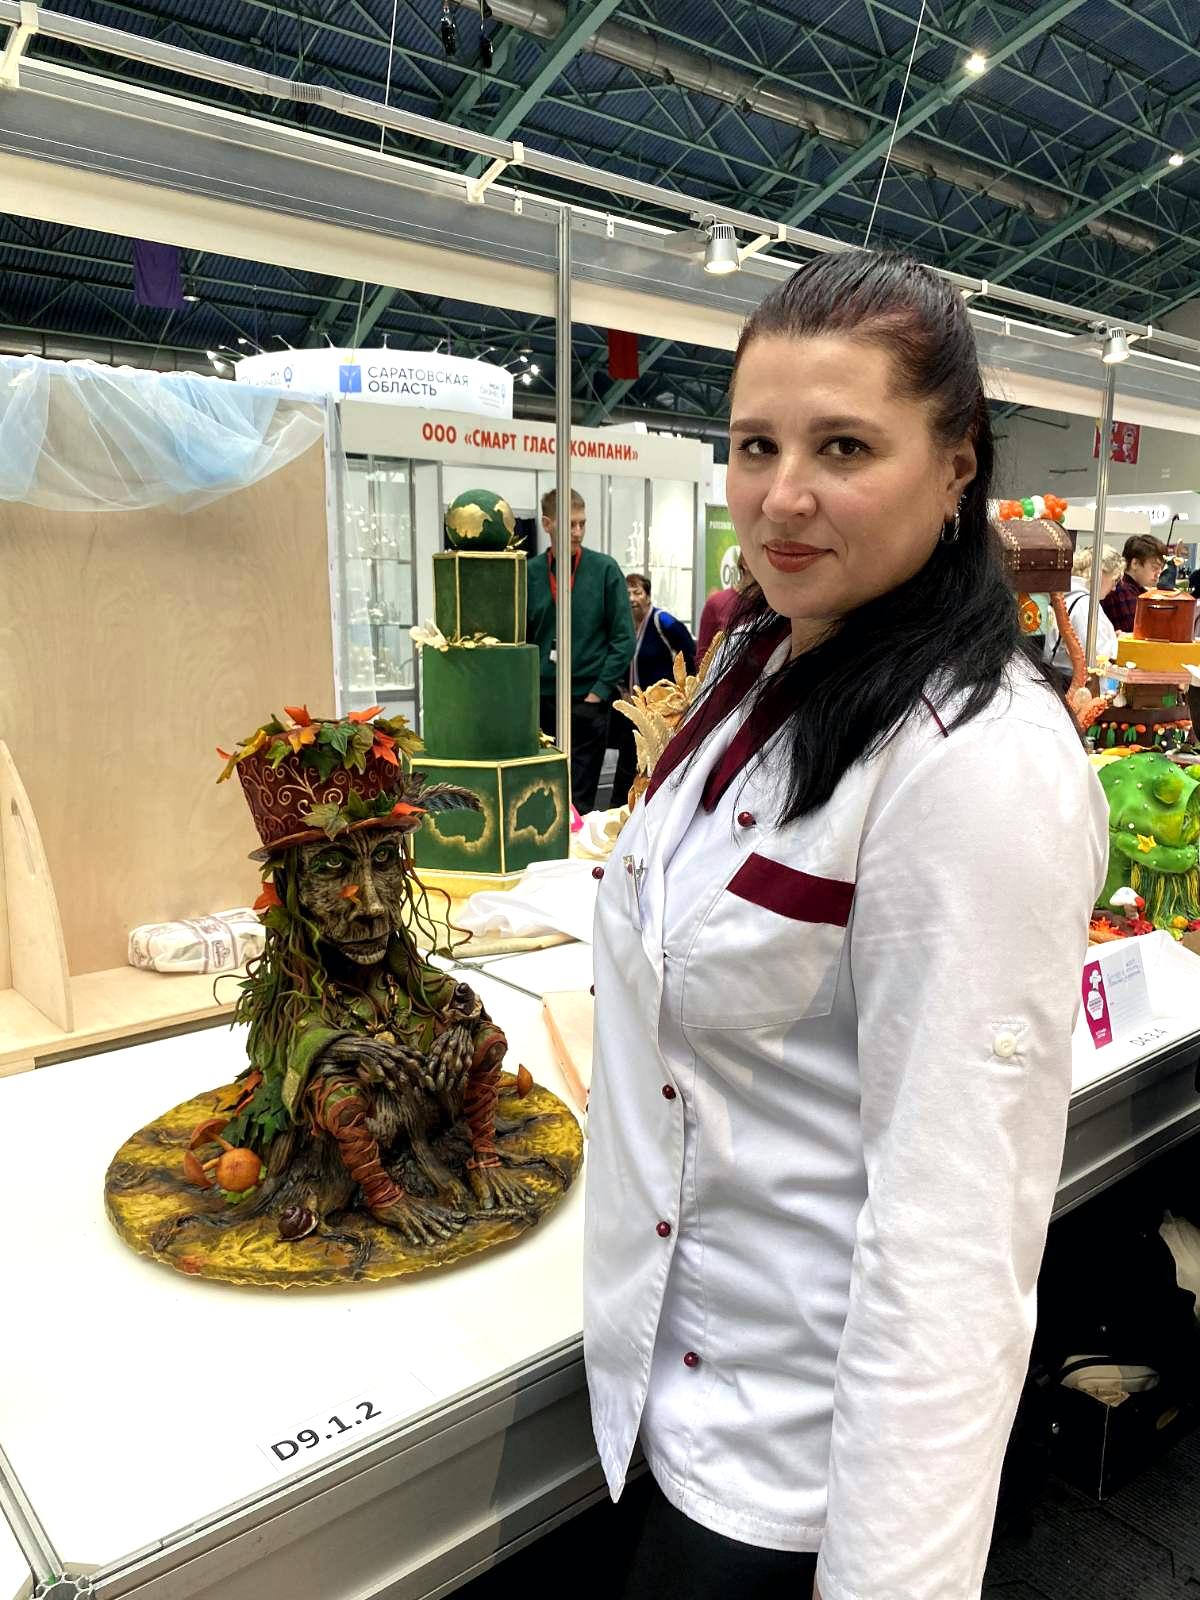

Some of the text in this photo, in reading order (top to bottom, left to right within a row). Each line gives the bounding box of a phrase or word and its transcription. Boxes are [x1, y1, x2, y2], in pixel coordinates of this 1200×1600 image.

[368, 366, 469, 387] САРАТОВСКАЯ
[368, 380, 437, 396] ОБЛАСТЬ
[422, 422, 639, 460] ООО «СМАРТ ГЛАС КОМПАНИ»
[270, 1400, 382, 1462] D9.1.2
